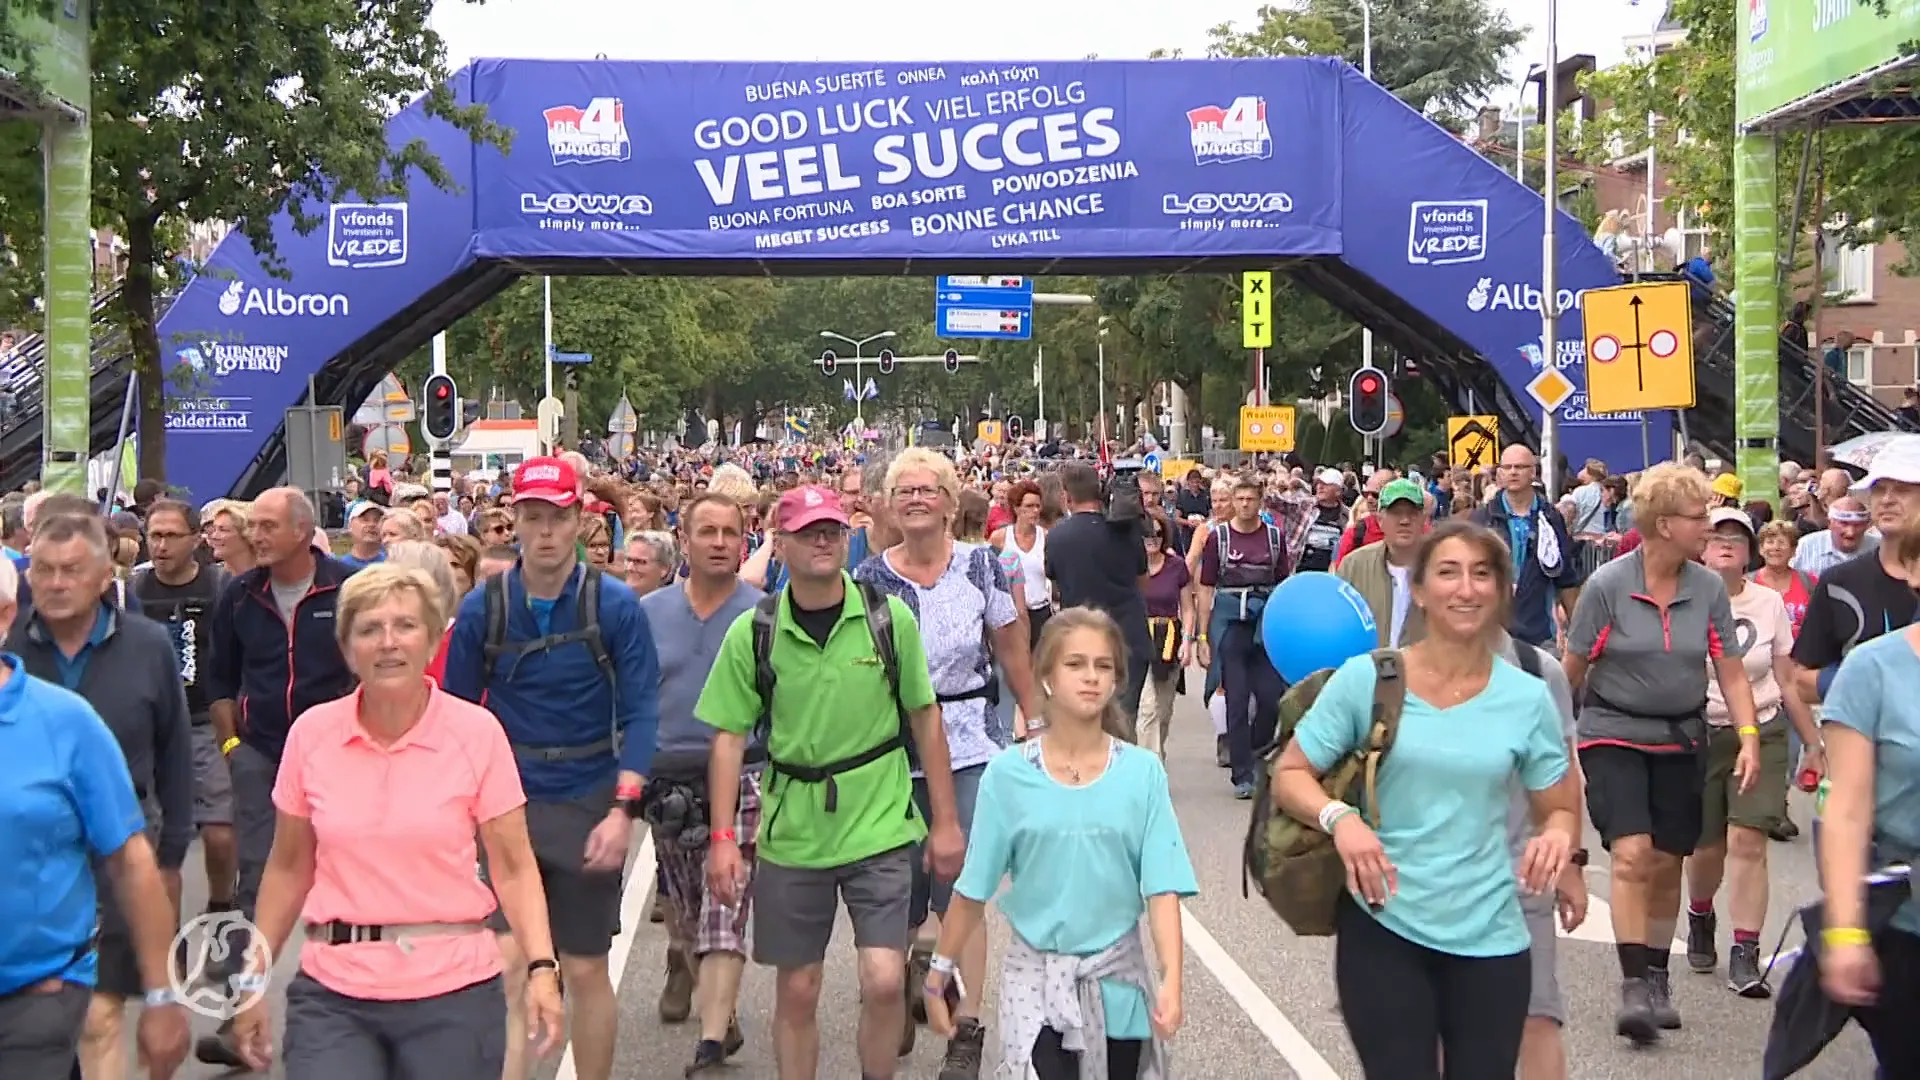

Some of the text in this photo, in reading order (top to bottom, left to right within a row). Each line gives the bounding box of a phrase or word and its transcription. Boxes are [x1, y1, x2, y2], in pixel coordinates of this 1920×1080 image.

[745, 69, 886, 102] BUENA SUERTE
[897, 67, 946, 85] ONNEA
[960, 65, 1039, 87] καλή τύχη
[925, 81, 1086, 122] VIEL ERFOLG
[580, 97, 621, 143] 4
[694, 95, 914, 150] GOOD LUCK
[1222, 96, 1264, 141] 4
[554, 141, 622, 156] DAAGSE
[693, 106, 1121, 206] VEEL SUCCES
[1197, 140, 1264, 156] DAAGSE
[992, 160, 1139, 195] POWODZENIA
[520, 193, 653, 215] LOWA
[871, 184, 967, 210] BOA SORTE
[1163, 192, 1293, 214] LOWA
[341, 211, 394, 226] vfonds
[540, 217, 585, 232] simply
[708, 199, 854, 231] BUONA FORTUNA
[911, 193, 1105, 237] BONNE CHANCE
[1180, 217, 1225, 231] simply
[1422, 207, 1474, 223] vfonds
[755, 219, 890, 249] MEGET SUCCESS
[991, 228, 1061, 248] LYKA TILL
[1413, 234, 1482, 253] VREDE
[333, 239, 403, 256] VREDE
[242, 289, 349, 317] Albron
[200, 340, 289, 360] VRIENDEN
